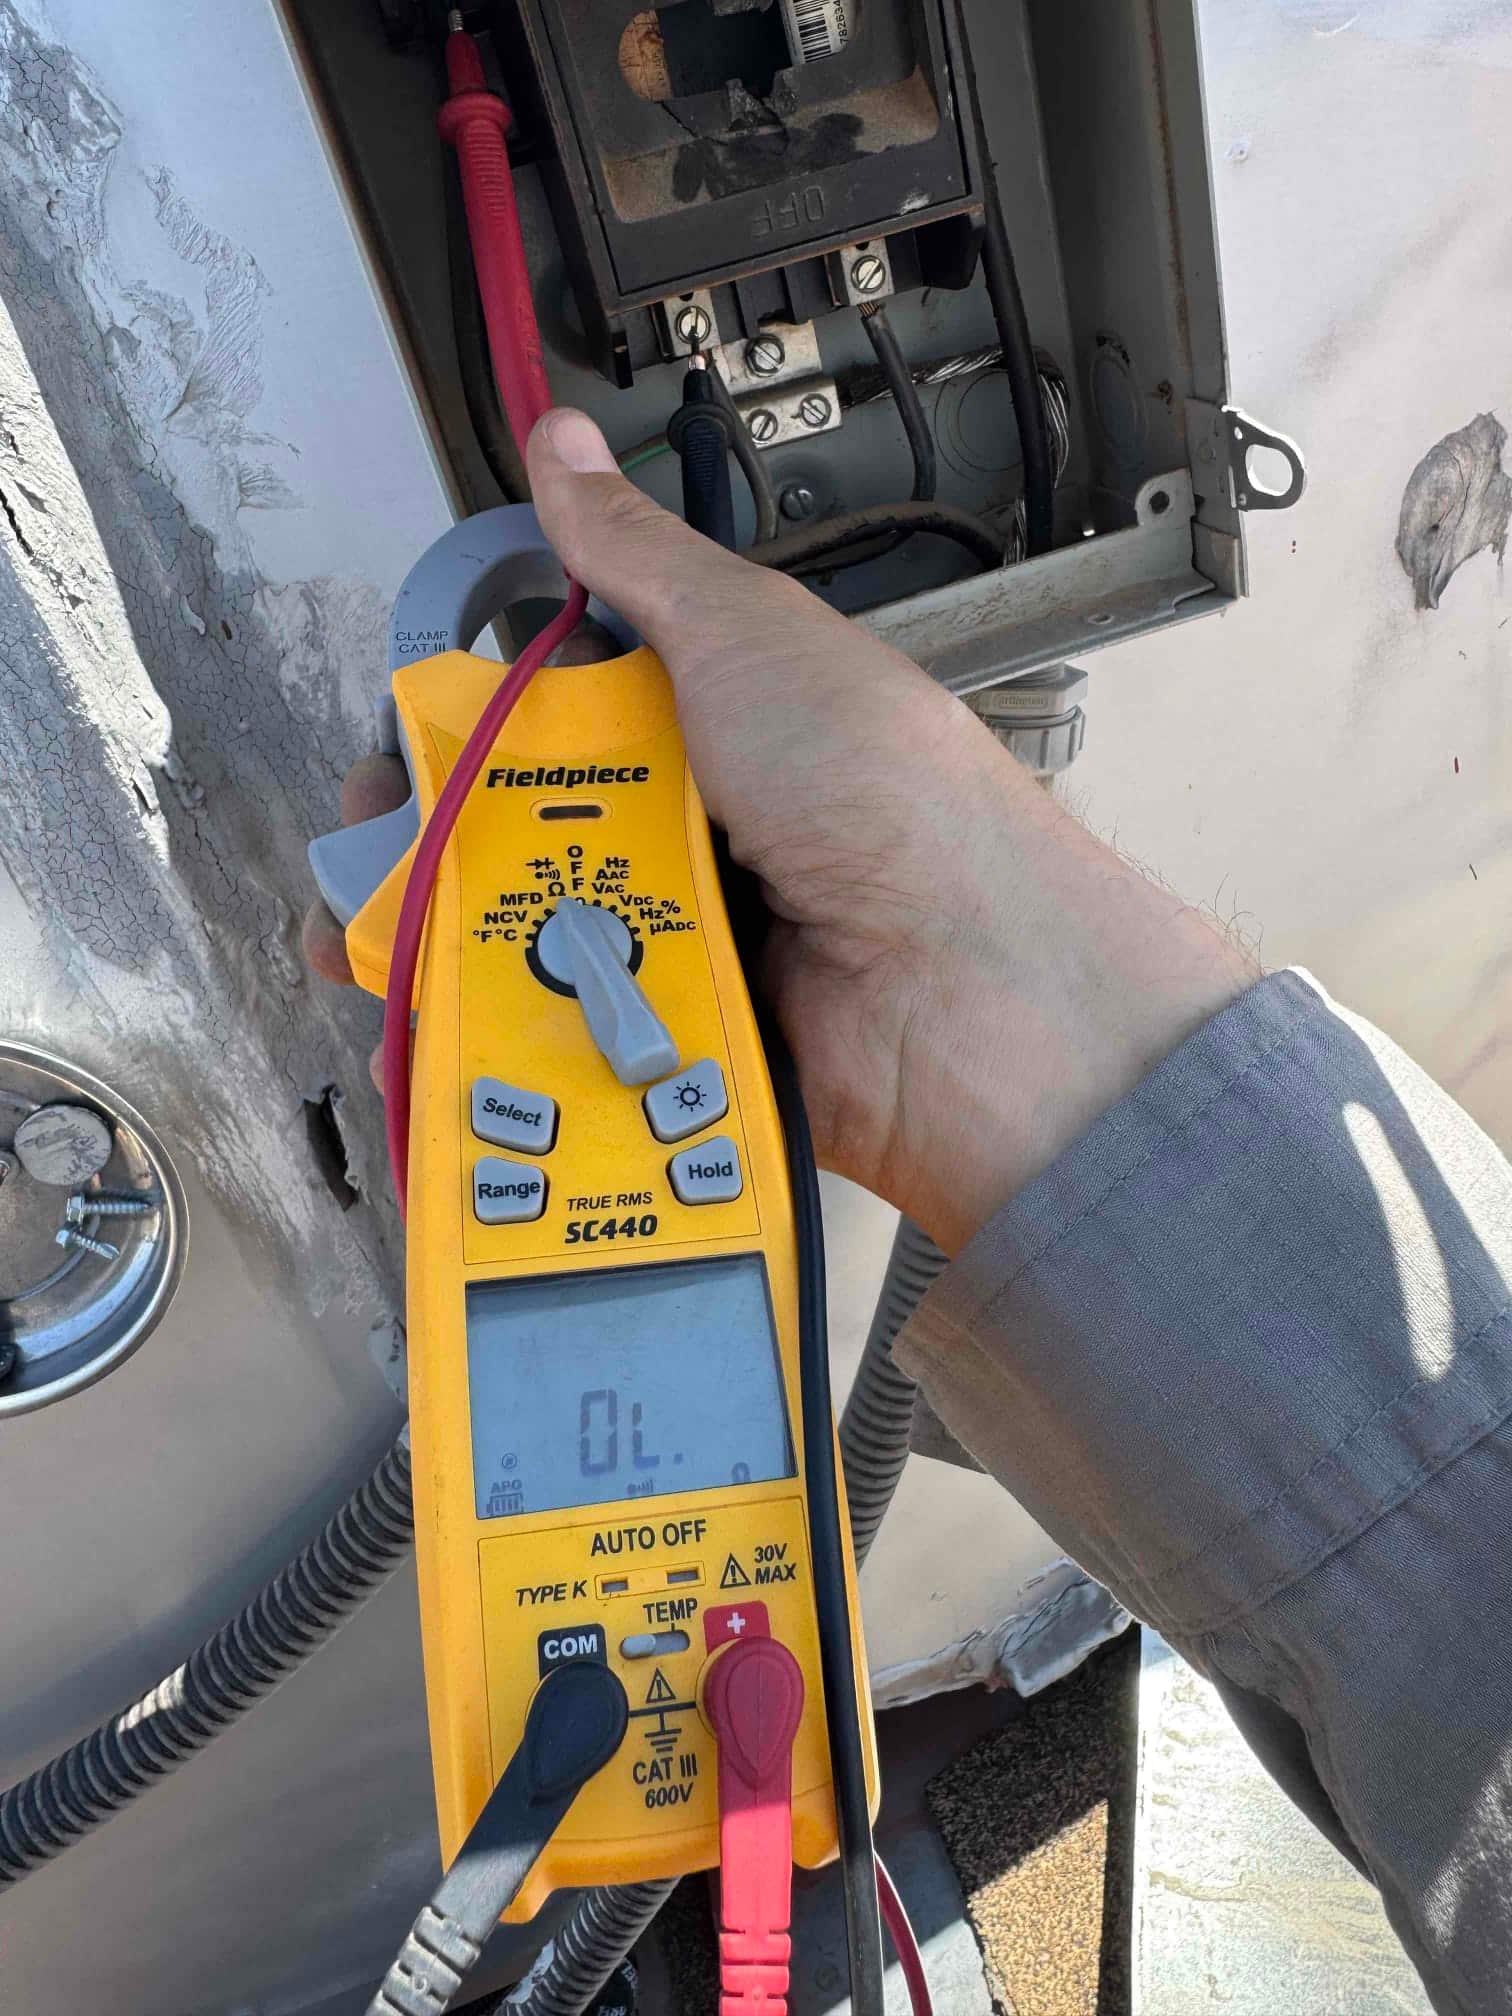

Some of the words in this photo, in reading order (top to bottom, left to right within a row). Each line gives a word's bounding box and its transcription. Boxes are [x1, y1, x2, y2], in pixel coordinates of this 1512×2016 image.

[396, 631, 449, 642] CLAMP
[398, 643, 430, 654] CAT
[486, 766, 650, 788] Fieldpiece
[605, 857, 630, 868] Hz
[499, 892, 544, 906] MFD
[483, 910, 528, 924] NCV
[482, 1097, 543, 1127] Select
[688, 1161, 733, 1180] Hold
[478, 1181, 541, 1199] Range
[567, 1195, 611, 1211] TRUE
[616, 1191, 653, 1208] RMS
[564, 1214, 658, 1244] SC440
[591, 1525, 656, 1557] AUTO
[662, 1519, 707, 1547] OFF
[754, 1543, 788, 1564] 30V
[754, 1563, 797, 1585] MAX
[516, 1582, 567, 1607] TYPE
[572, 1579, 588, 1600] K
[642, 1597, 699, 1625] TEMP
[543, 1633, 599, 1660] COM
[632, 1757, 673, 1785] CAT
[680, 1752, 698, 1778] III
[644, 1782, 694, 1809] 600V
